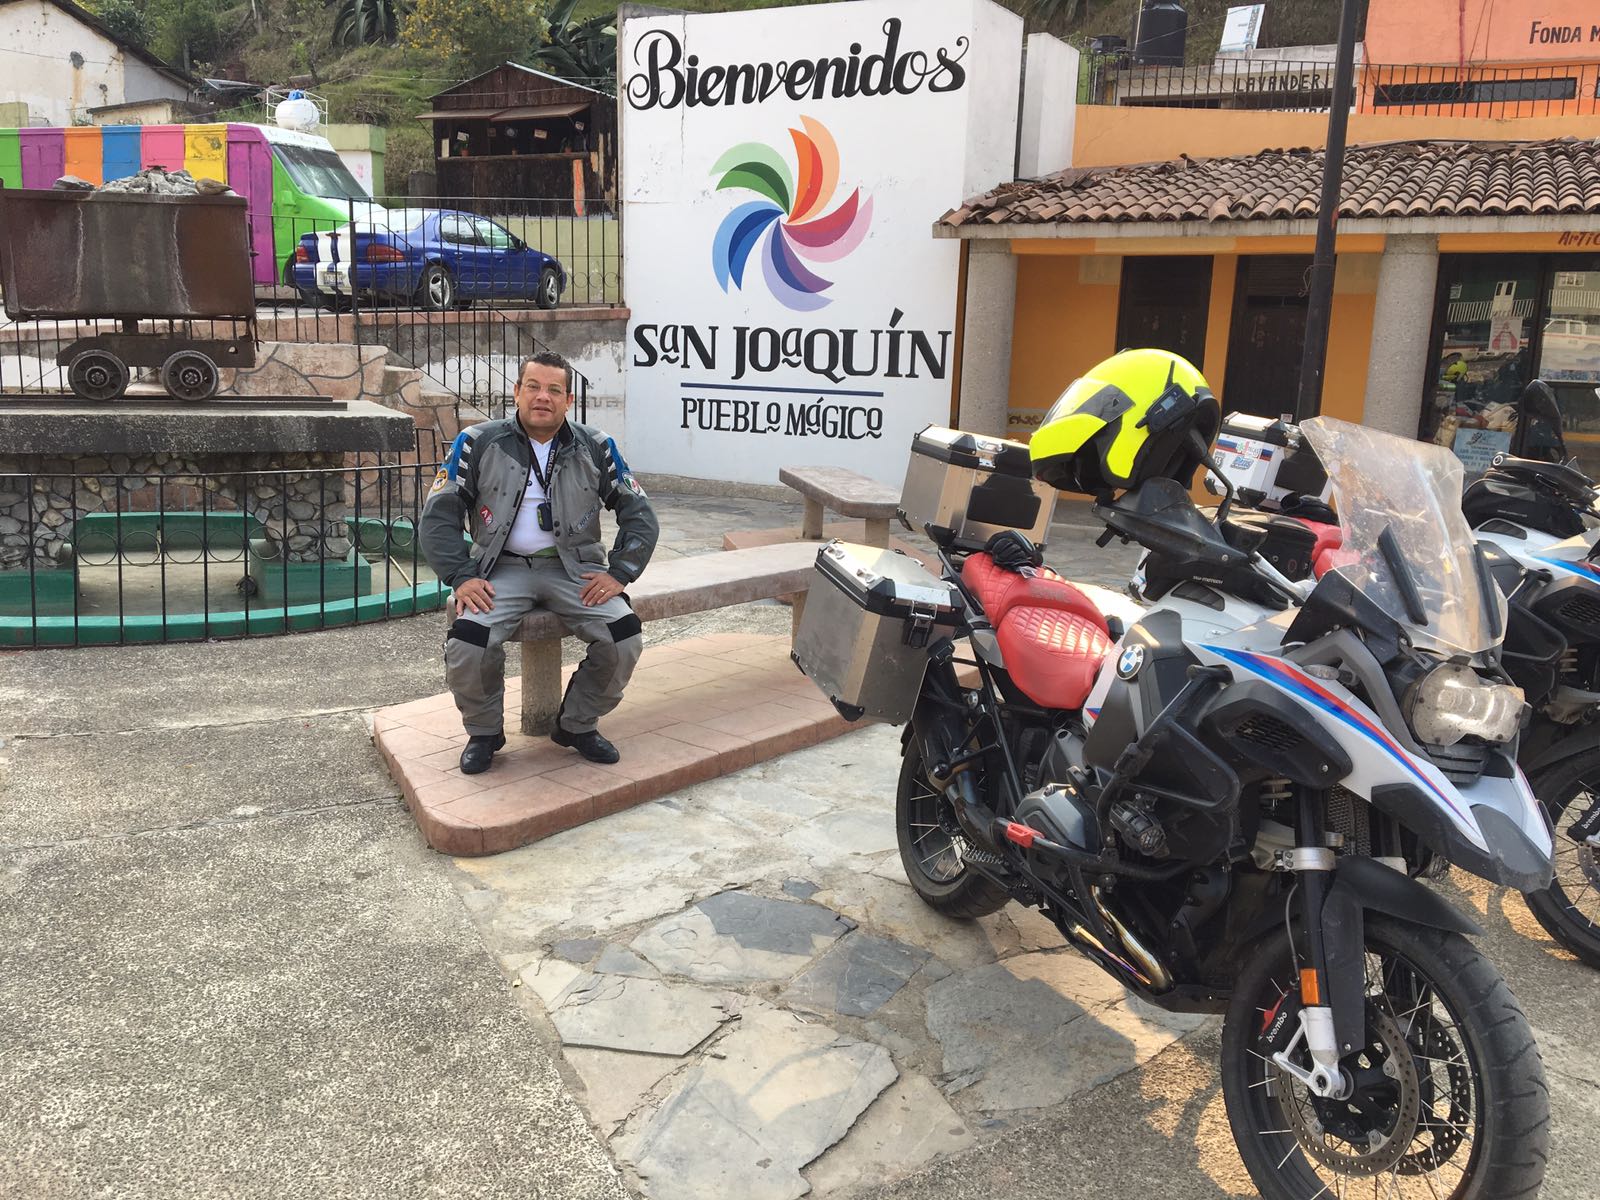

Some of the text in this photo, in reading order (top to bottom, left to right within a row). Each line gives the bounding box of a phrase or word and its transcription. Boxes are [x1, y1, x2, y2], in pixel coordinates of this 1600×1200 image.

[1529, 21, 1581, 44] FONDA
[627, 17, 969, 110] Bienvenidos
[1266, 1012, 1288, 1043] brembo
